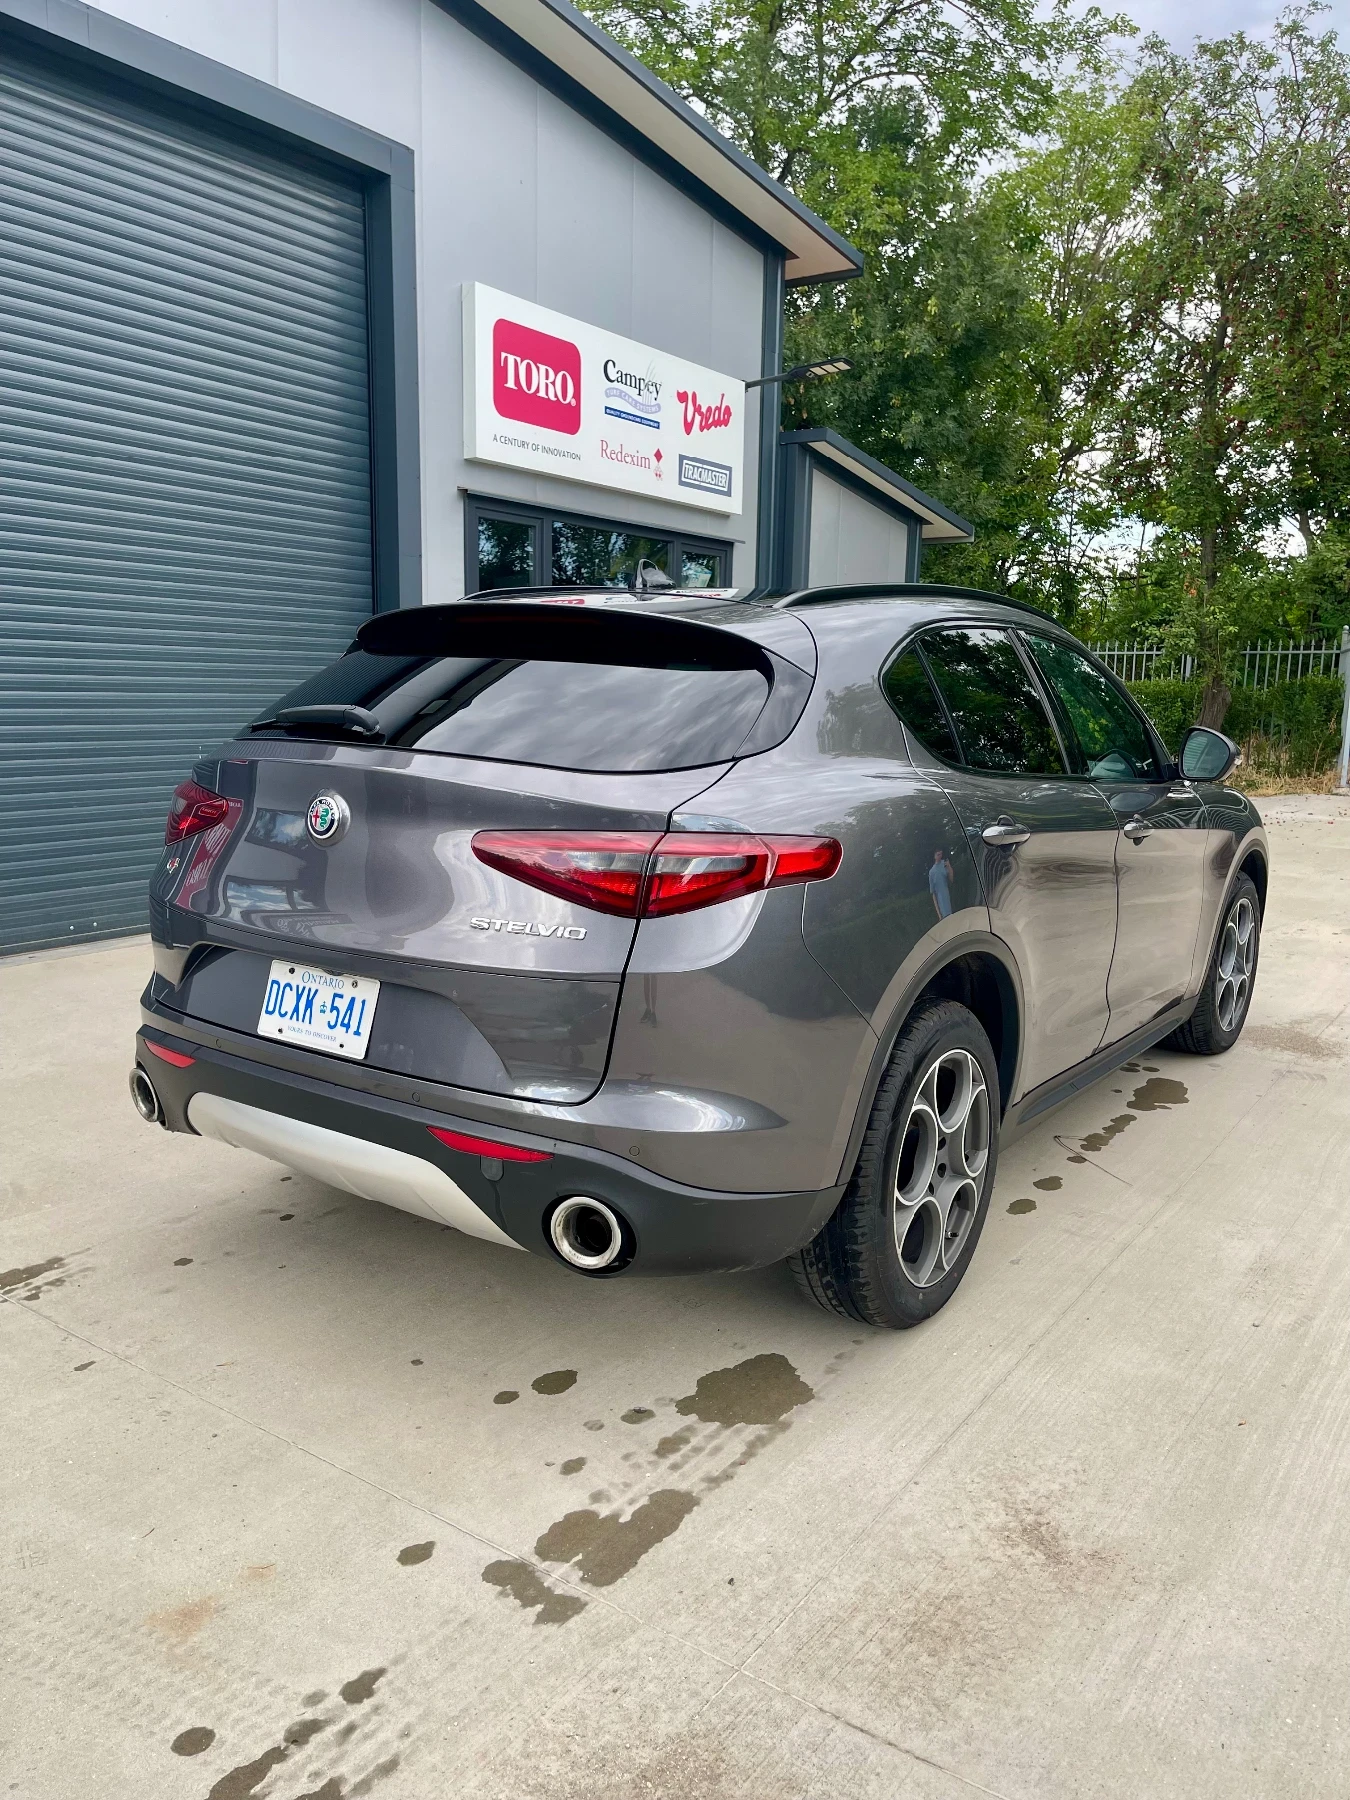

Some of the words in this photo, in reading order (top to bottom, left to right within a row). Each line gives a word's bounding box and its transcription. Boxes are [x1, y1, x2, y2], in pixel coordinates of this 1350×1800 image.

[501, 351, 576, 406] TORO
[603, 359, 662, 401] Campey
[636, 403, 659, 413] SYSTEMS
[676, 390, 732, 435] Vredo
[492, 433, 499, 443] A
[499, 435, 530, 450] CENTURY
[531, 442, 540, 452] OF
[541, 445, 581, 461] INNOVATION
[600, 439, 651, 470] Redexim
[684, 463, 728, 488] TRACMASTER
[470, 917, 588, 940] STELVIO
[302, 971, 344, 990] ONTARIO
[264, 979, 319, 1025] DCXK
[327, 992, 366, 1037] 541
